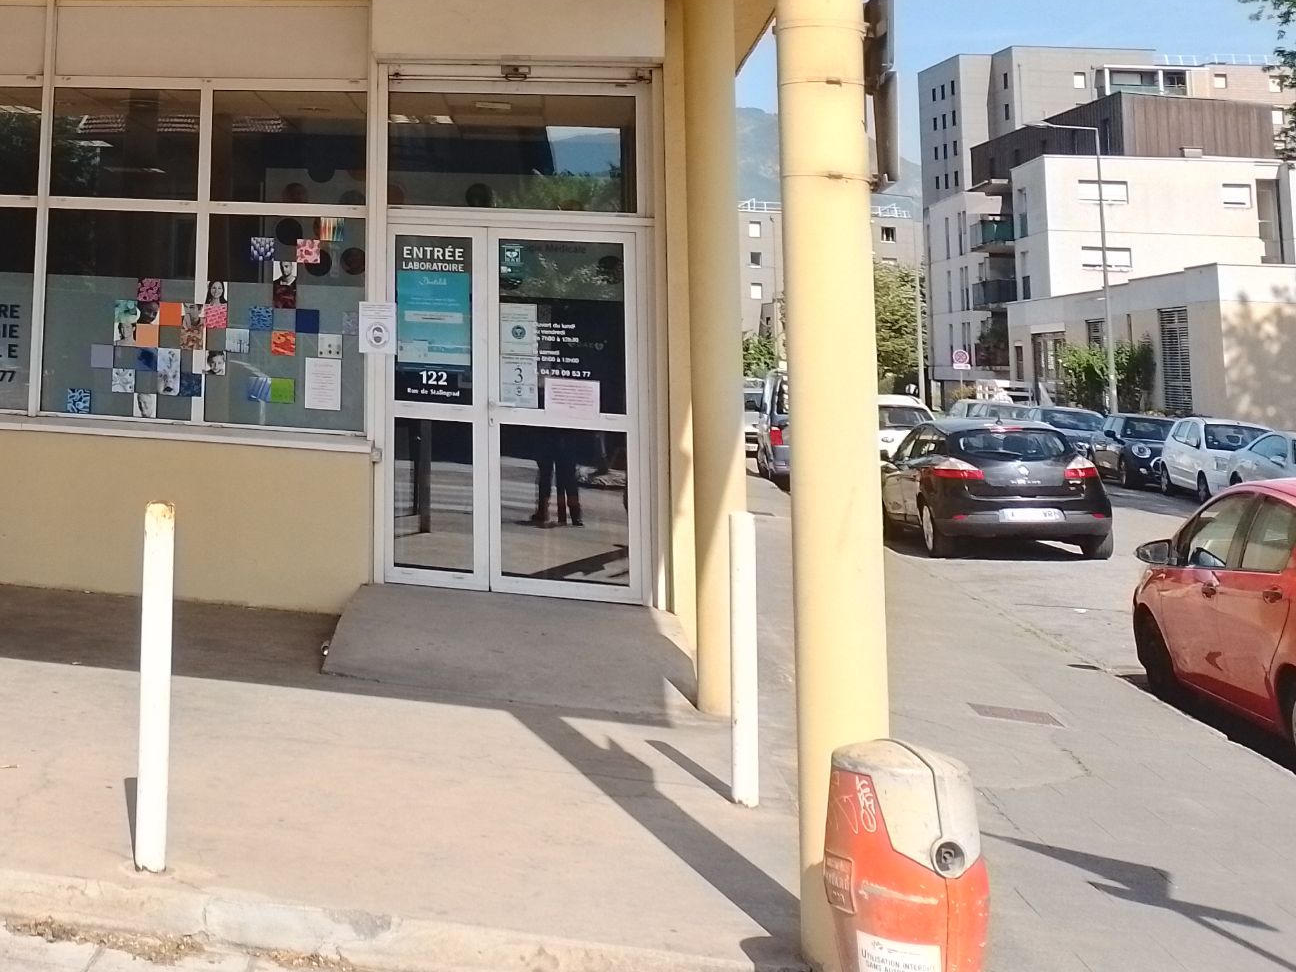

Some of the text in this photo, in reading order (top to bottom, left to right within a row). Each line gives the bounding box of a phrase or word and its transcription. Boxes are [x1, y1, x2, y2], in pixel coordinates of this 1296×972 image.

[403, 245, 464, 261] ENTRÉE
[402, 261, 464, 272] LABORATOIRE
[0, 370, 16, 383] 77
[419, 370, 448, 386] 122
[582, 370, 591, 378] 77
[430, 388, 460, 398] Stalingrad
